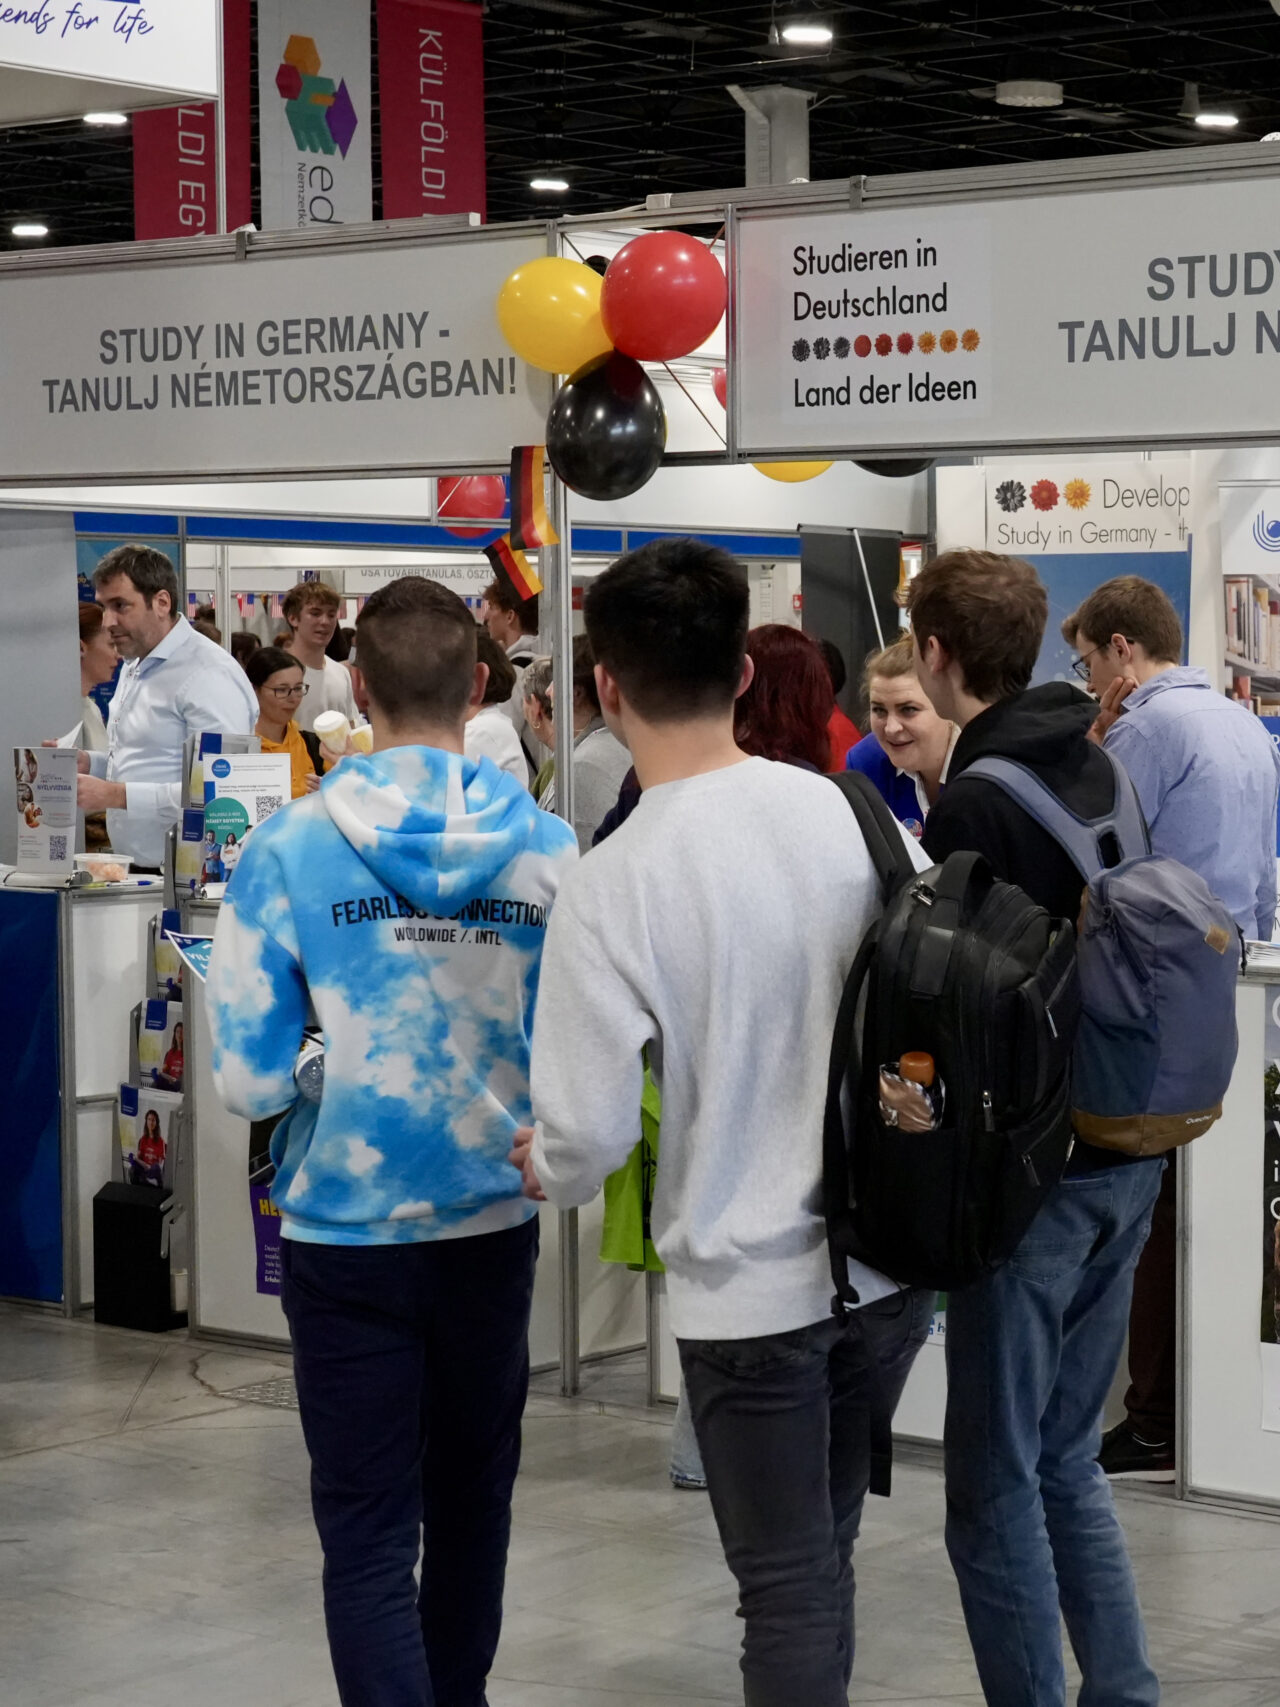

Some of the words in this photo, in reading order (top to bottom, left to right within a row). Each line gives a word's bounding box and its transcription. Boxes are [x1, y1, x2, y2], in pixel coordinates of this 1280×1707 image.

[61, 2, 98, 38] for
[113, 5, 154, 43] life
[419, 28, 449, 199] KÜLFÖLDI
[793, 243, 908, 276] Studieren
[917, 238, 938, 267] in
[793, 282, 948, 321] Deutschland
[100, 325, 205, 365] STUDY
[215, 322, 244, 360] IN
[256, 311, 430, 357] GERMANY
[1058, 311, 1237, 363] TANULJ
[42, 375, 160, 413] TANULJ
[170, 356, 517, 409] NÉMETORSZÁGBAN!
[794, 377, 851, 407] Land
[858, 374, 902, 404] der
[908, 372, 977, 403] Ideen
[997, 521, 1051, 551] Study
[1058, 525, 1073, 544] in
[1080, 521, 1157, 549] Germany
